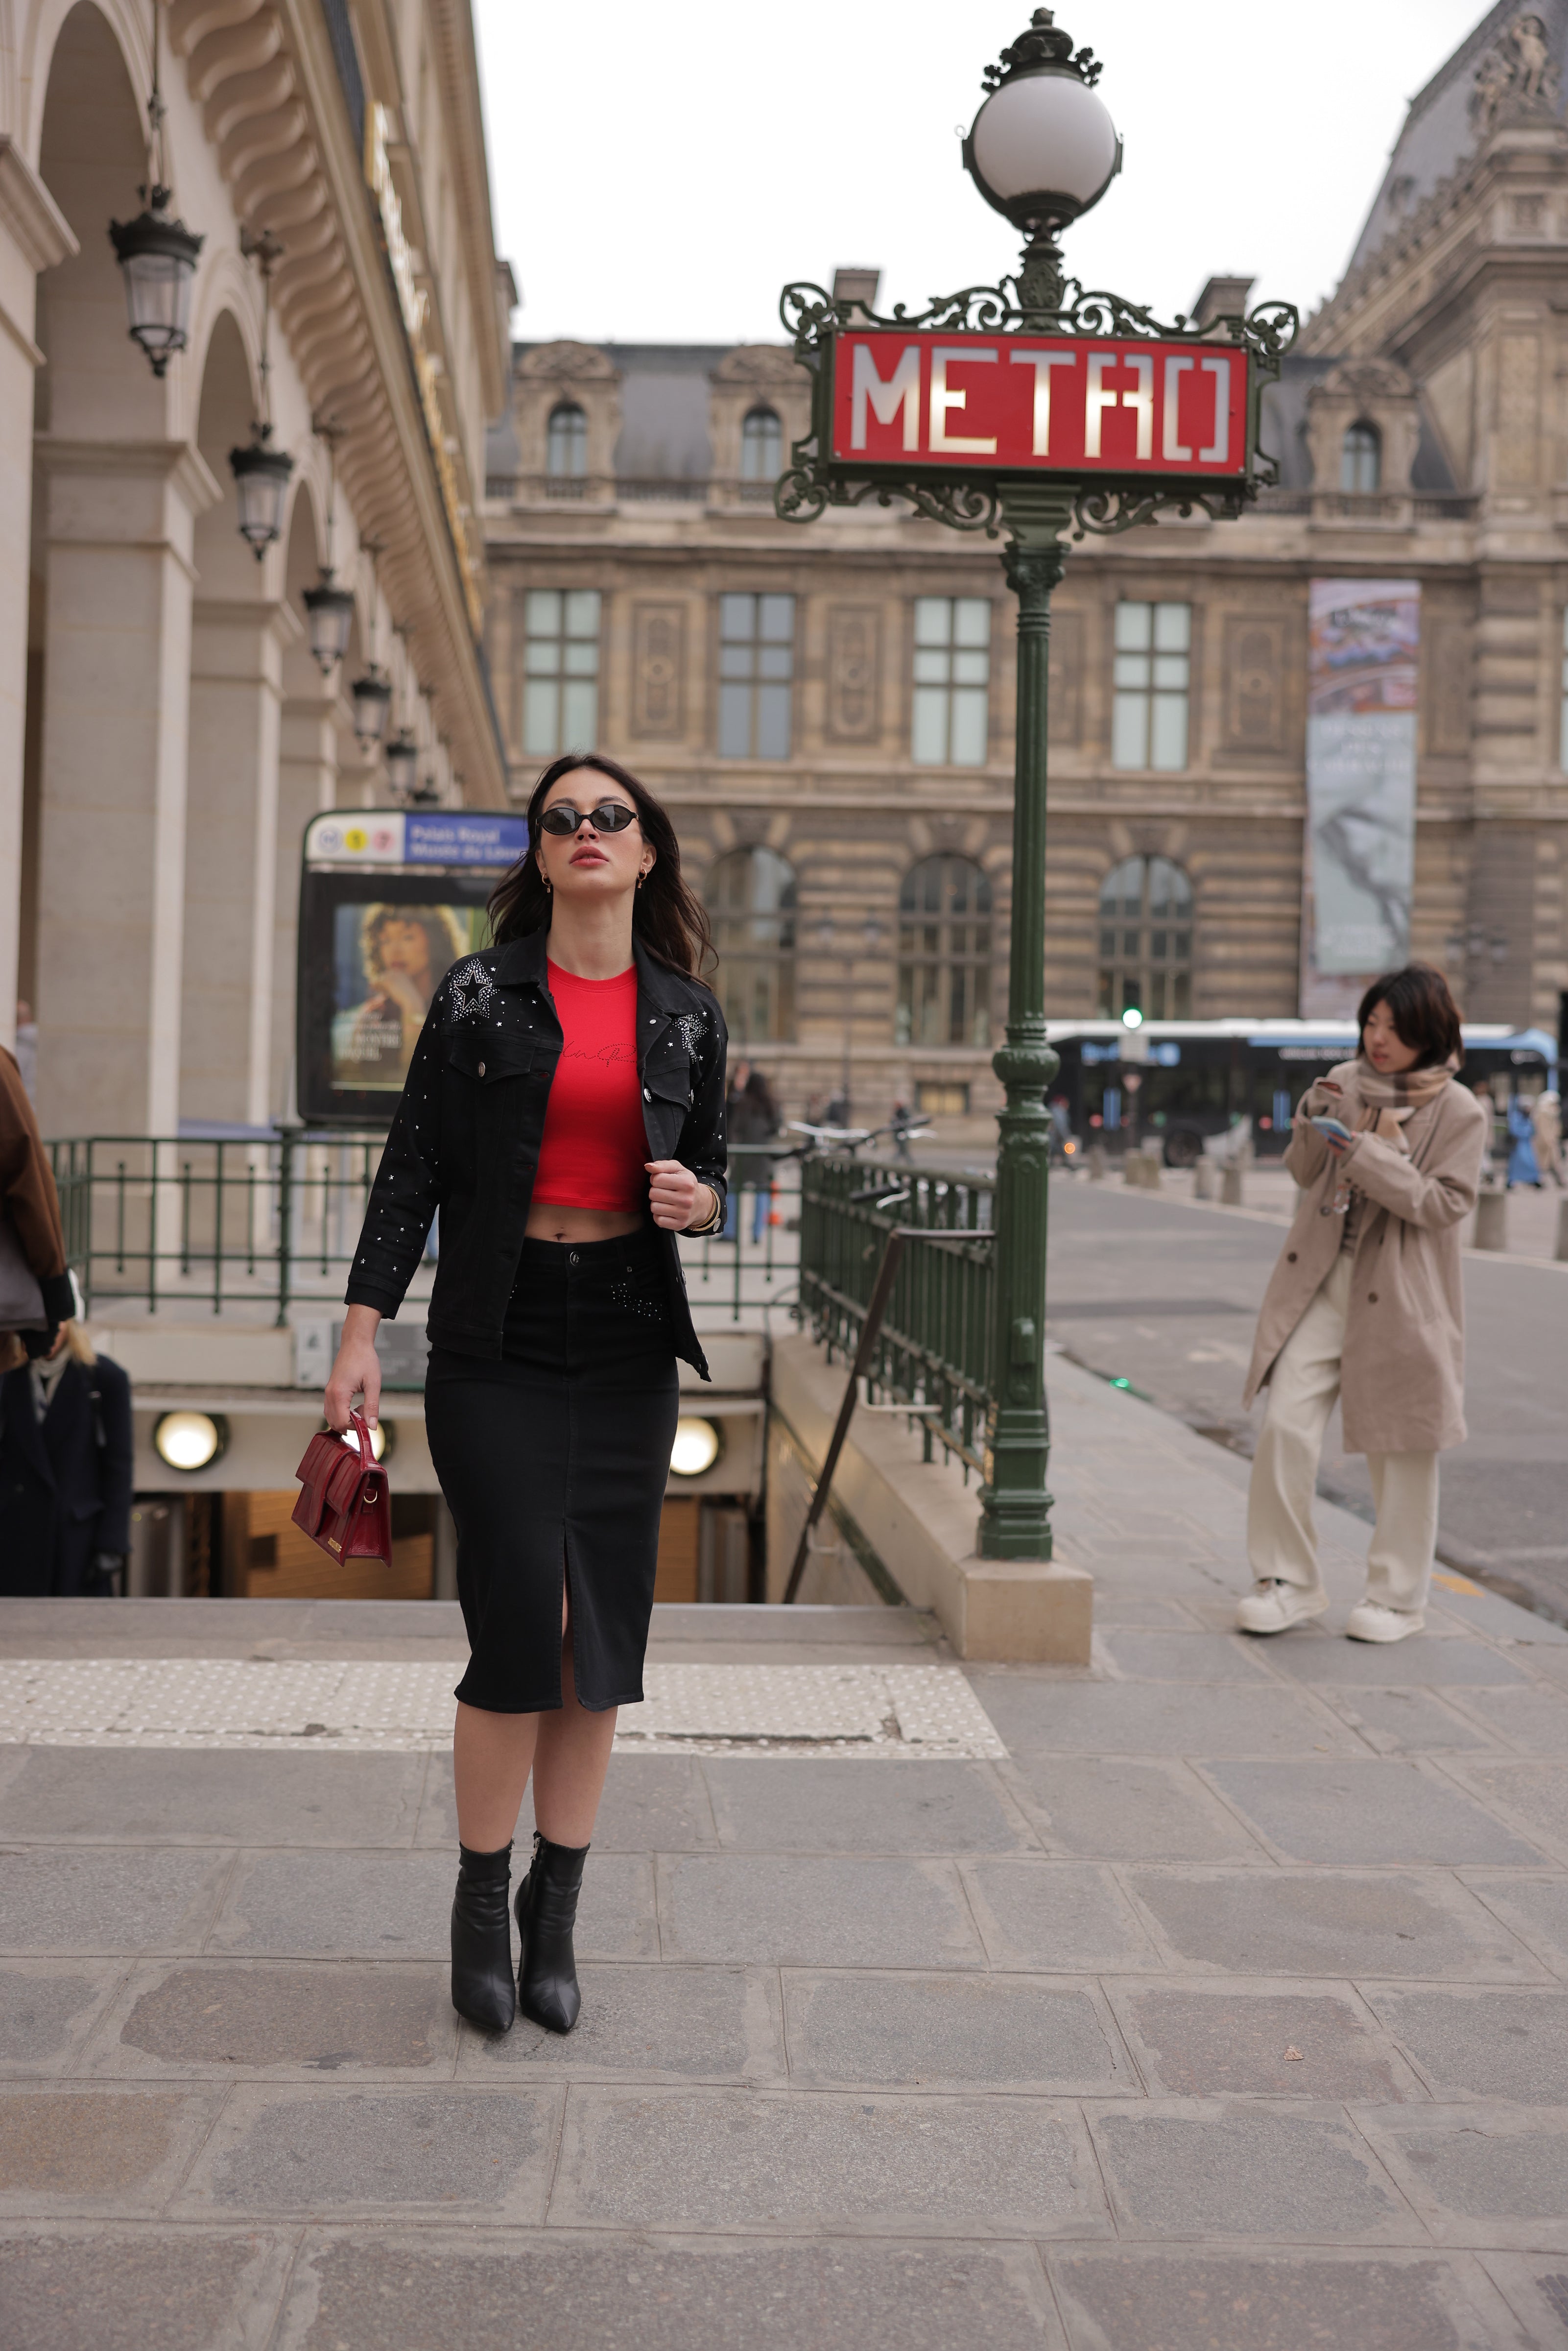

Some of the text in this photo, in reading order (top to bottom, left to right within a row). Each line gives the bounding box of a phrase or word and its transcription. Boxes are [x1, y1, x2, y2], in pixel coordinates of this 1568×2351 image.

[851, 344, 1231, 463] METRO
[410, 825, 500, 846] Palais Royal
[462, 844, 482, 860] du
[484, 845, 528, 861] Louv
